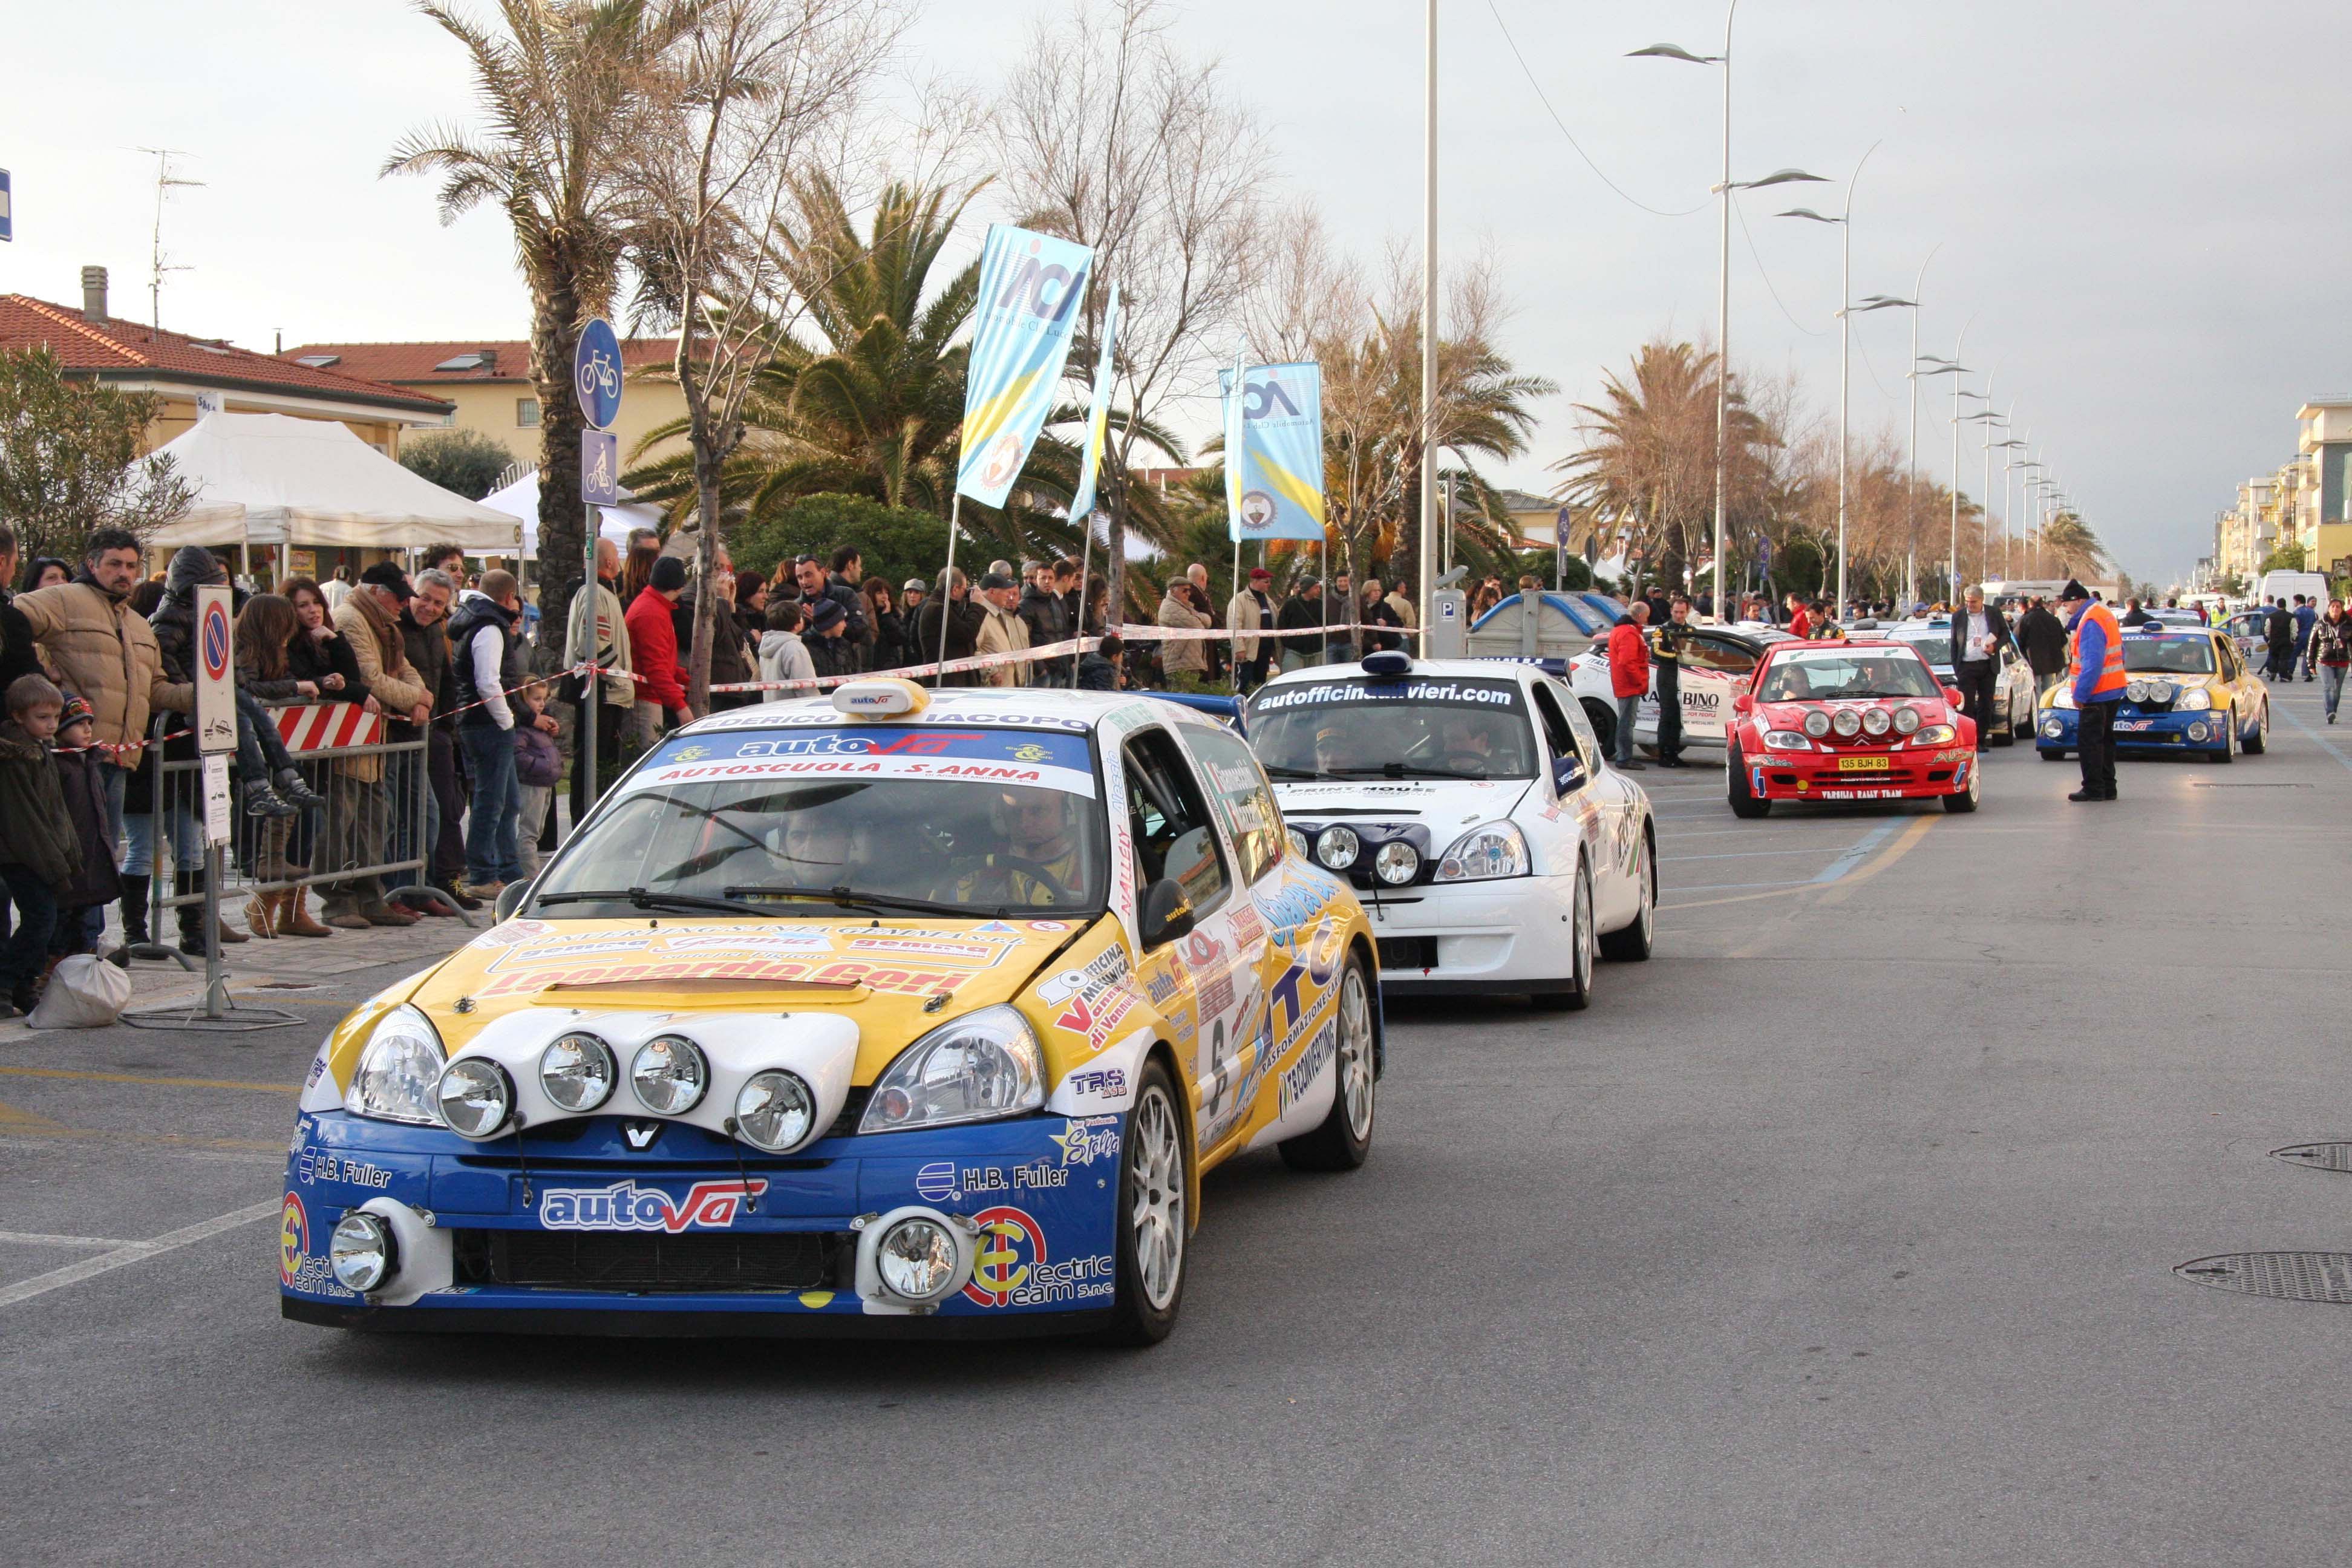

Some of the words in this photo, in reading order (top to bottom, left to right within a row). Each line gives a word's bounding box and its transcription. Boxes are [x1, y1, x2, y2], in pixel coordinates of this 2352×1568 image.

[1047, 325, 1071, 340] Lucc
[1443, 603, 1453, 615] P
[1258, 682, 1512, 711] autofficinvieri.com
[925, 714, 1091, 729] IACOPO
[658, 762, 881, 781] AUTOSCUOLA
[1841, 760, 1854, 768] 135
[1858, 759, 1873, 768] BJH
[1877, 759, 1887, 767] 83
[1822, 790, 1854, 799] VERSILIA
[1857, 790, 1878, 799] RALLY
[1881, 789, 1902, 798] TEAM
[512, 925, 724, 948] CONVERTING
[728, 925, 833, 933] SANTA
[837, 926, 963, 940] GEMMA
[852, 938, 991, 956] gemma
[1069, 1068, 1125, 1094] TRS
[315, 1161, 340, 1182] H.B.
[342, 1160, 392, 1189] Fuller
[962, 1168, 1009, 1192] H.B.
[1013, 1165, 1069, 1190] Fuller
